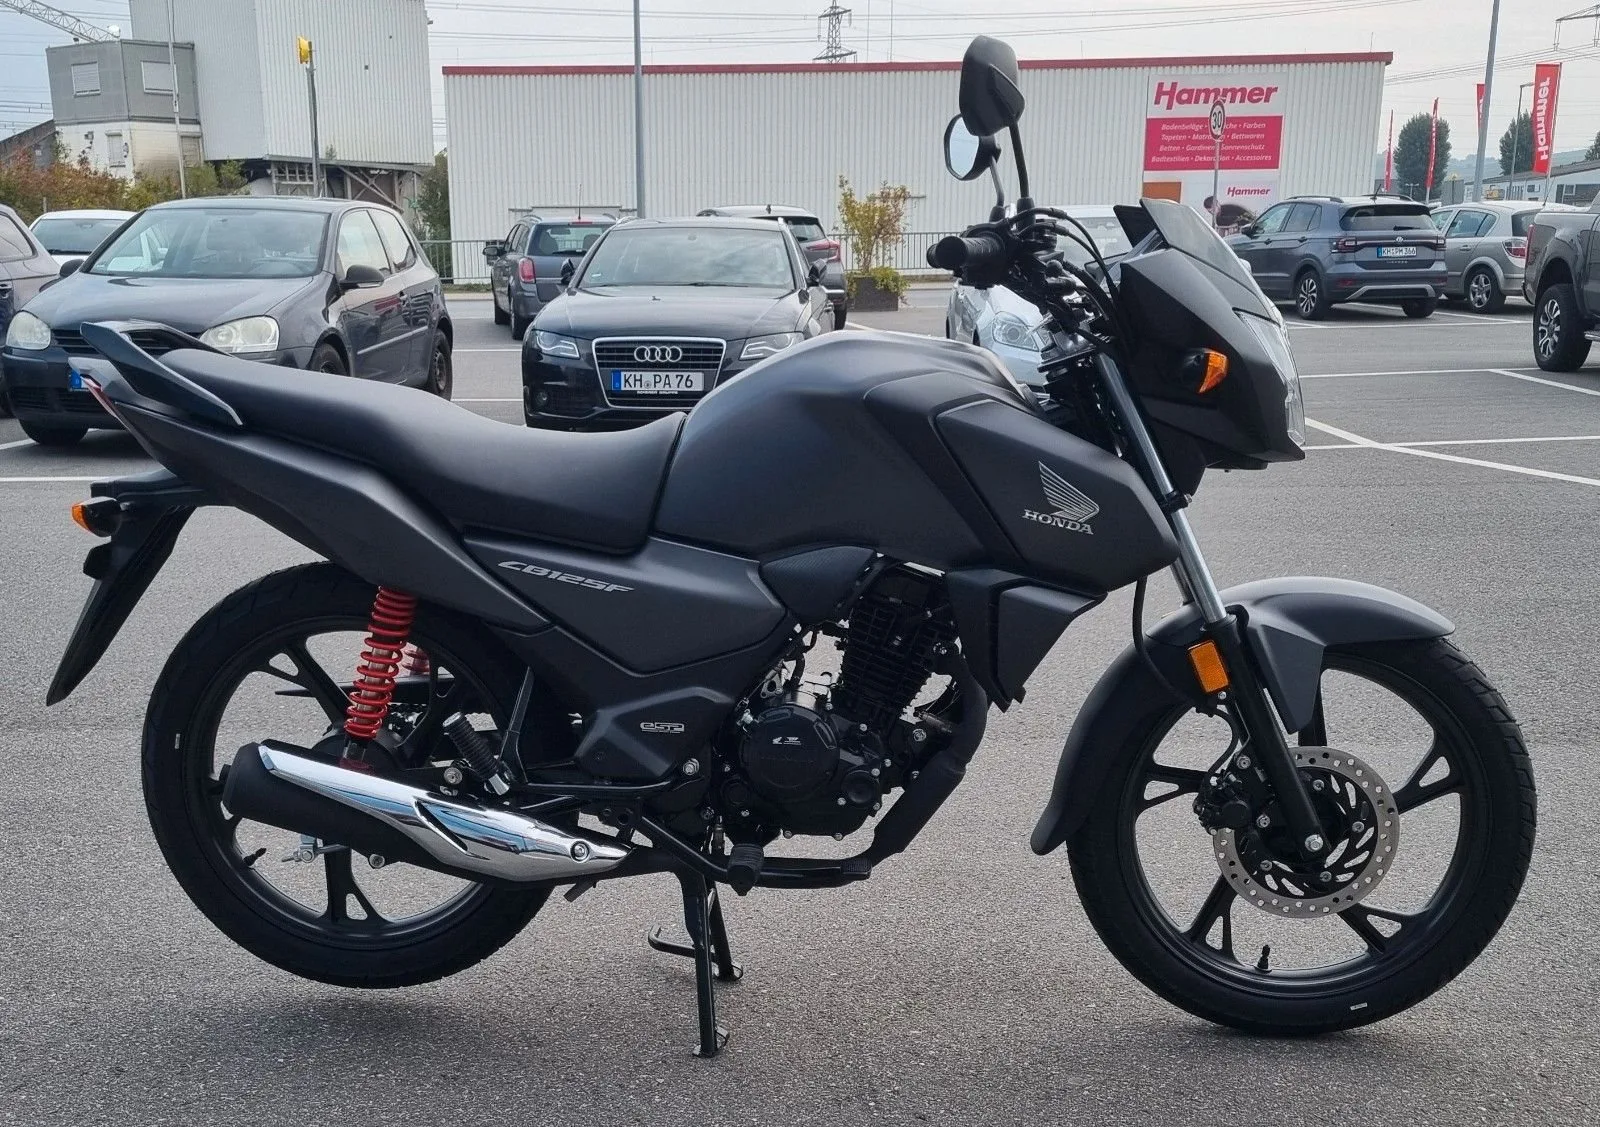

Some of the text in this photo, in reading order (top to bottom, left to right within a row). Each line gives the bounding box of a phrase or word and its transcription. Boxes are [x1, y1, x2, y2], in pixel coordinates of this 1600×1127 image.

[1154, 82, 1278, 110] Hammer
[1212, 111, 1222, 130] 30
[1537, 77, 1550, 160] Hammer
[1161, 134, 1187, 142] Tapeten
[1227, 186, 1271, 197] Hammer
[623, 374, 643, 389] KH
[653, 374, 672, 389] PA
[675, 374, 694, 389] 76
[1021, 509, 1094, 535] HONDA
[498, 560, 635, 592] CB125F
